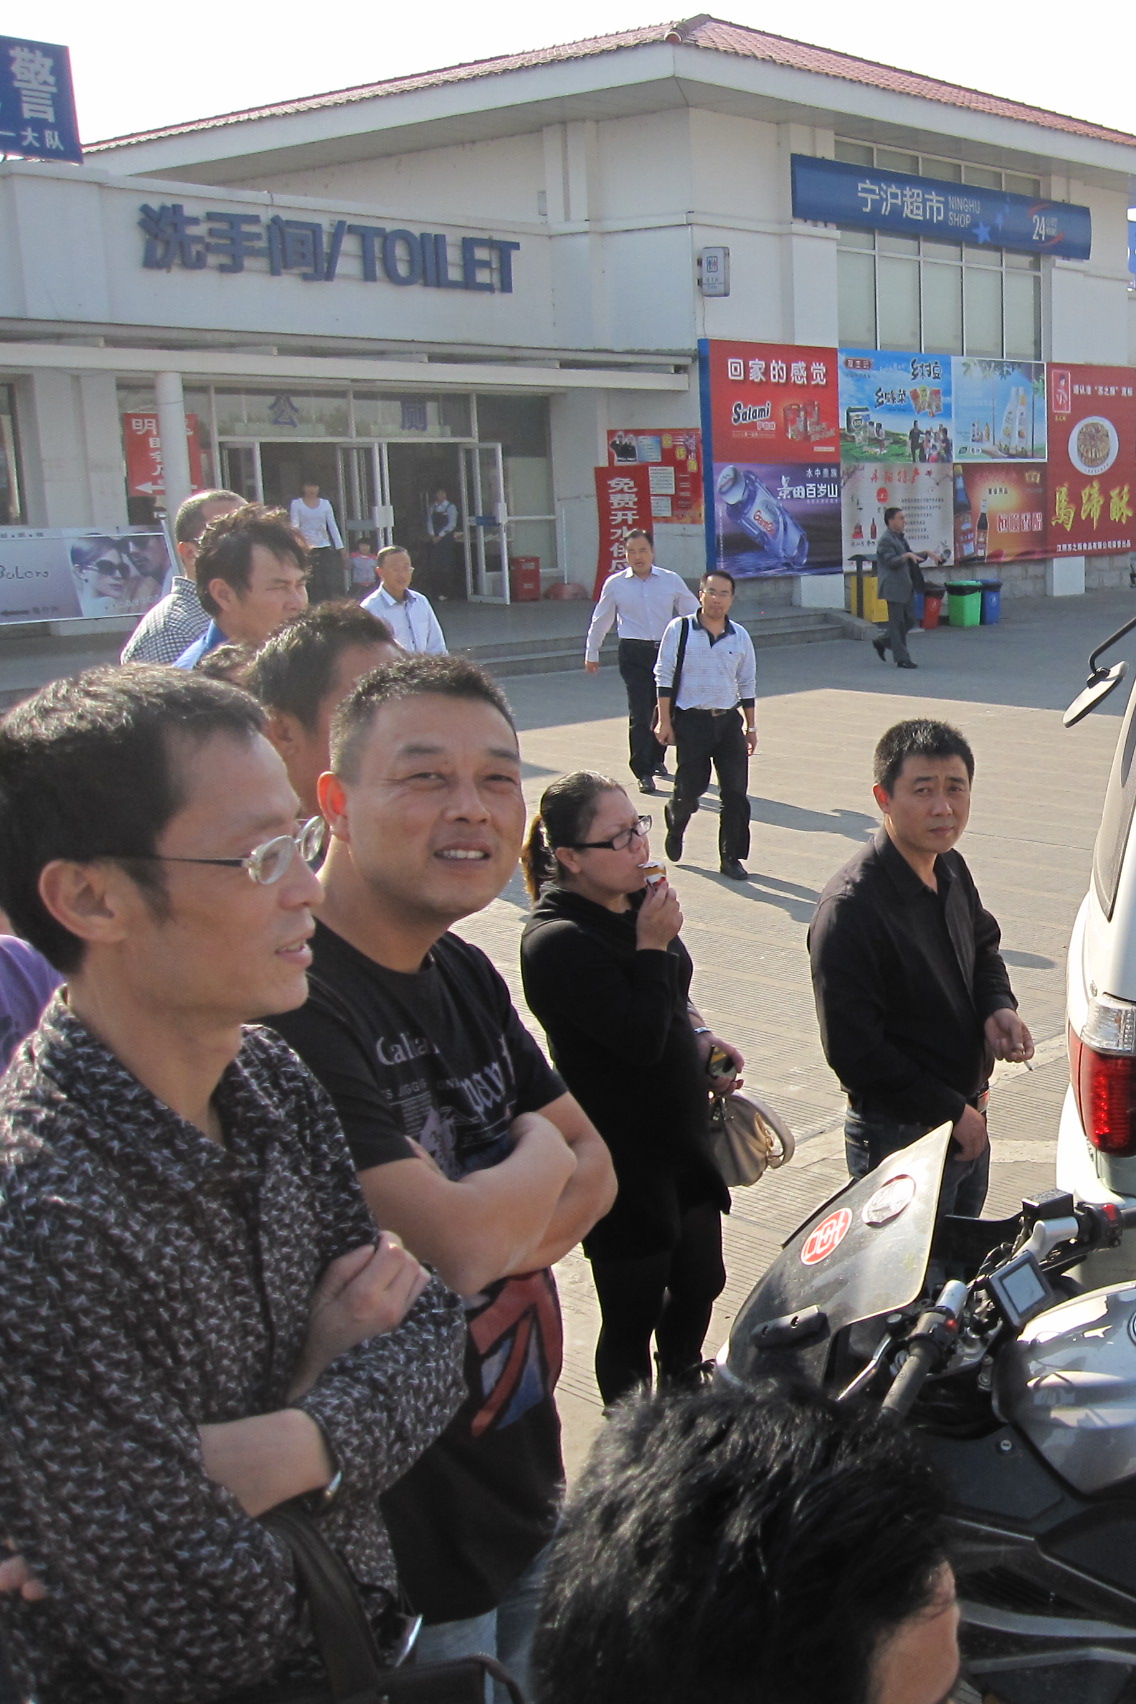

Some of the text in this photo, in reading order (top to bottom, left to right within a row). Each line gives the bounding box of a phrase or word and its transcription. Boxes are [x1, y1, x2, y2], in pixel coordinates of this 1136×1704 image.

[9, 46, 57, 123] 警
[857, 179, 945, 223] 宁沪超市
[948, 195, 981, 214] NINGHU
[948, 211, 971, 228] SHOP
[1032, 214, 1046, 241] 24
[728, 358, 826, 385] 回家的感觉
[731, 400, 771, 425] Salami
